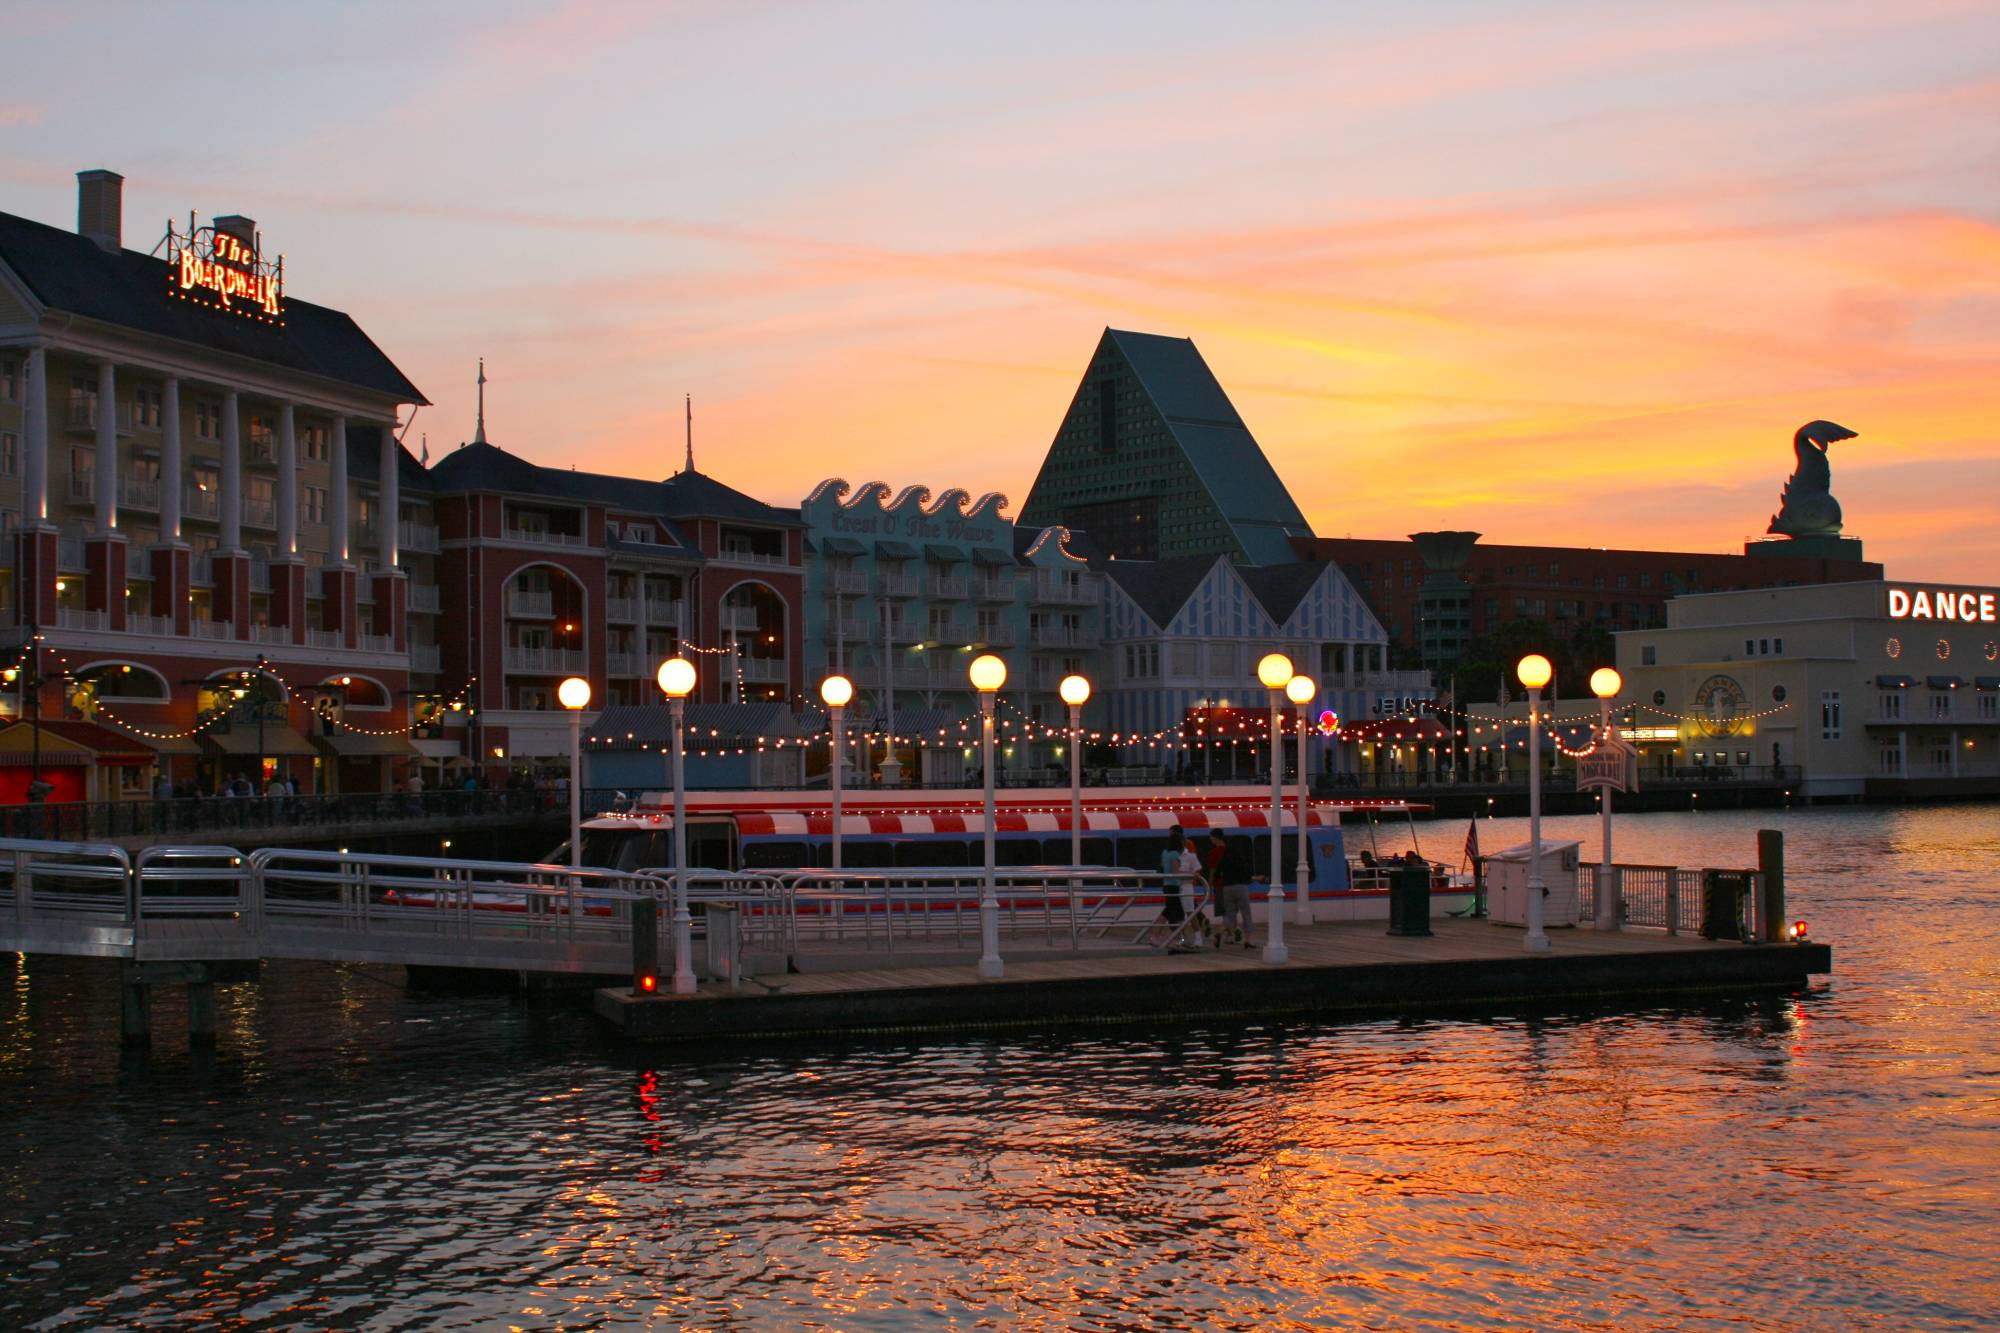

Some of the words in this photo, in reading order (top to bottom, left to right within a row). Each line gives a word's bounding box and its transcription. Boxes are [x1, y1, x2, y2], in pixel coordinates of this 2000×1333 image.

[215, 233, 251, 265] The
[180, 248, 279, 316] BOARDWALK
[831, 510, 880, 534] Crest
[906, 514, 941, 539] The
[945, 519, 996, 543] Wave
[1889, 589, 1997, 622] DANCE
